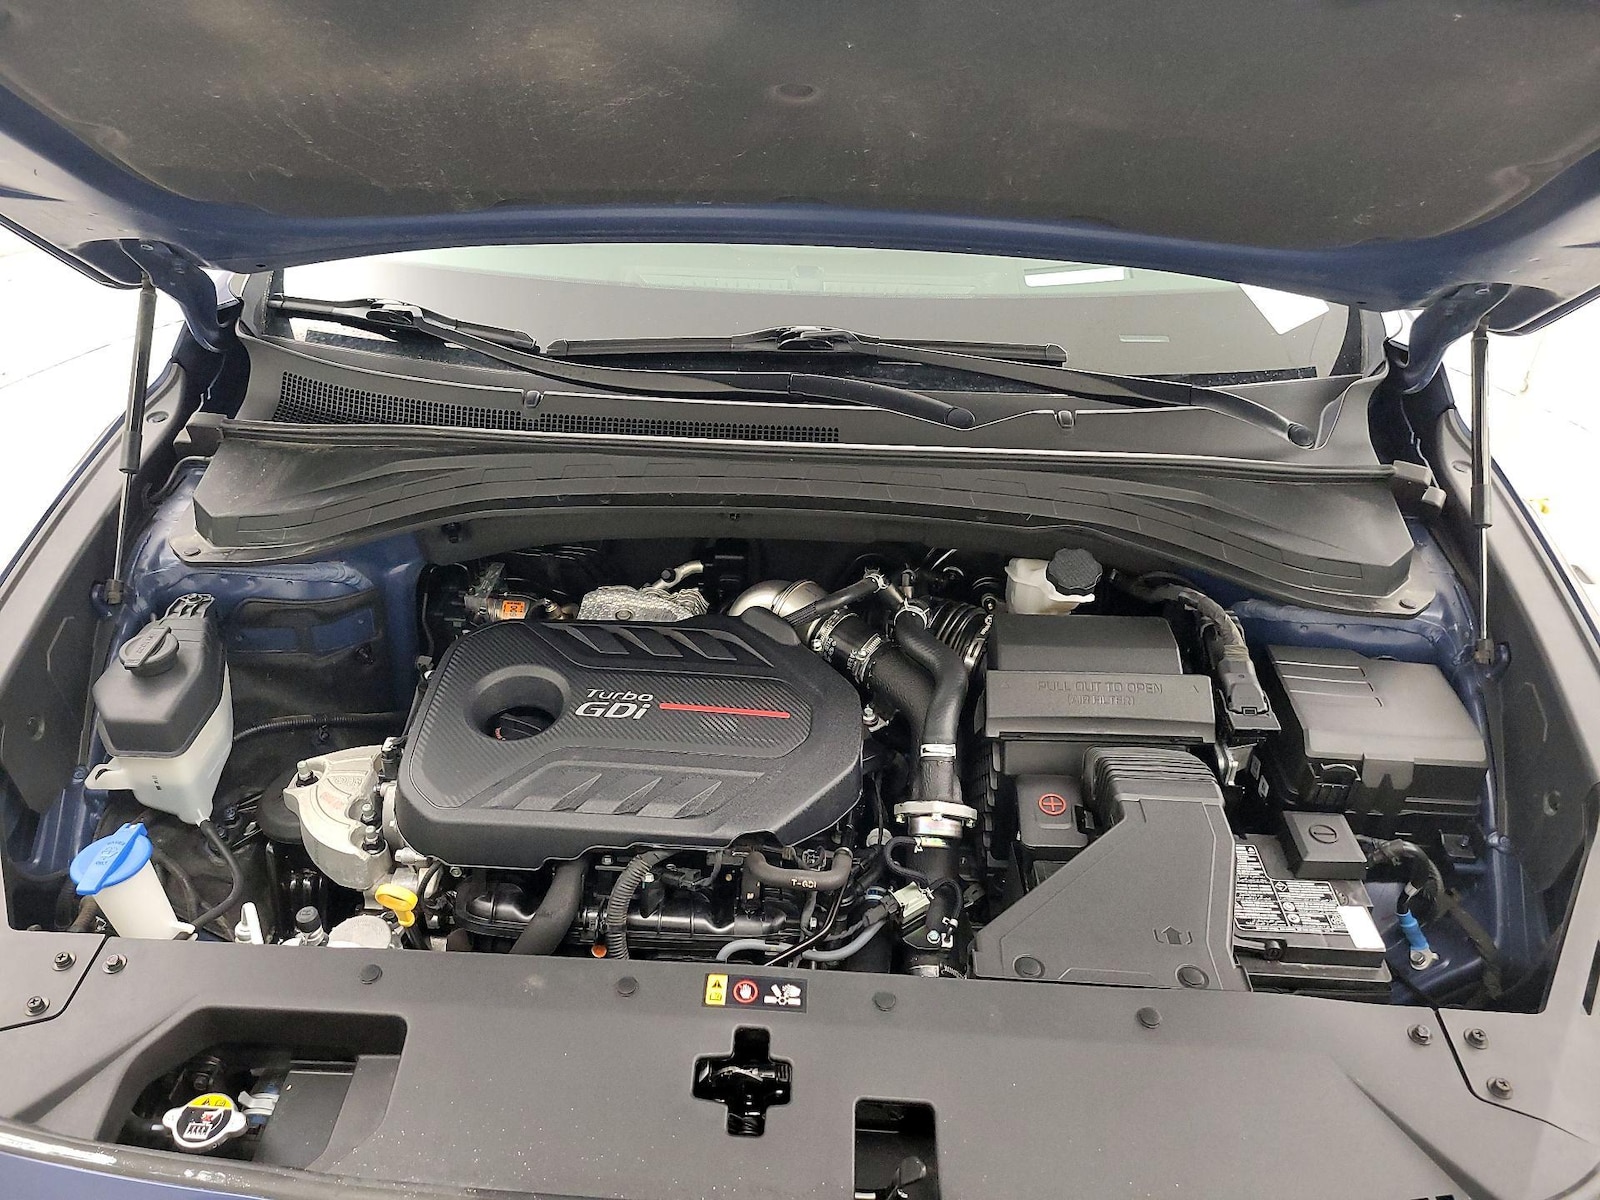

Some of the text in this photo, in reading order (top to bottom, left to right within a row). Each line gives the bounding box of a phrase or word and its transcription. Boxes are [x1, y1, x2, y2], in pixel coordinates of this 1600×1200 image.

[1038, 681, 1163, 693] PULL OUT TO OPEN
[587, 688, 654, 701] Turbo
[575, 702, 651, 719] GDi
